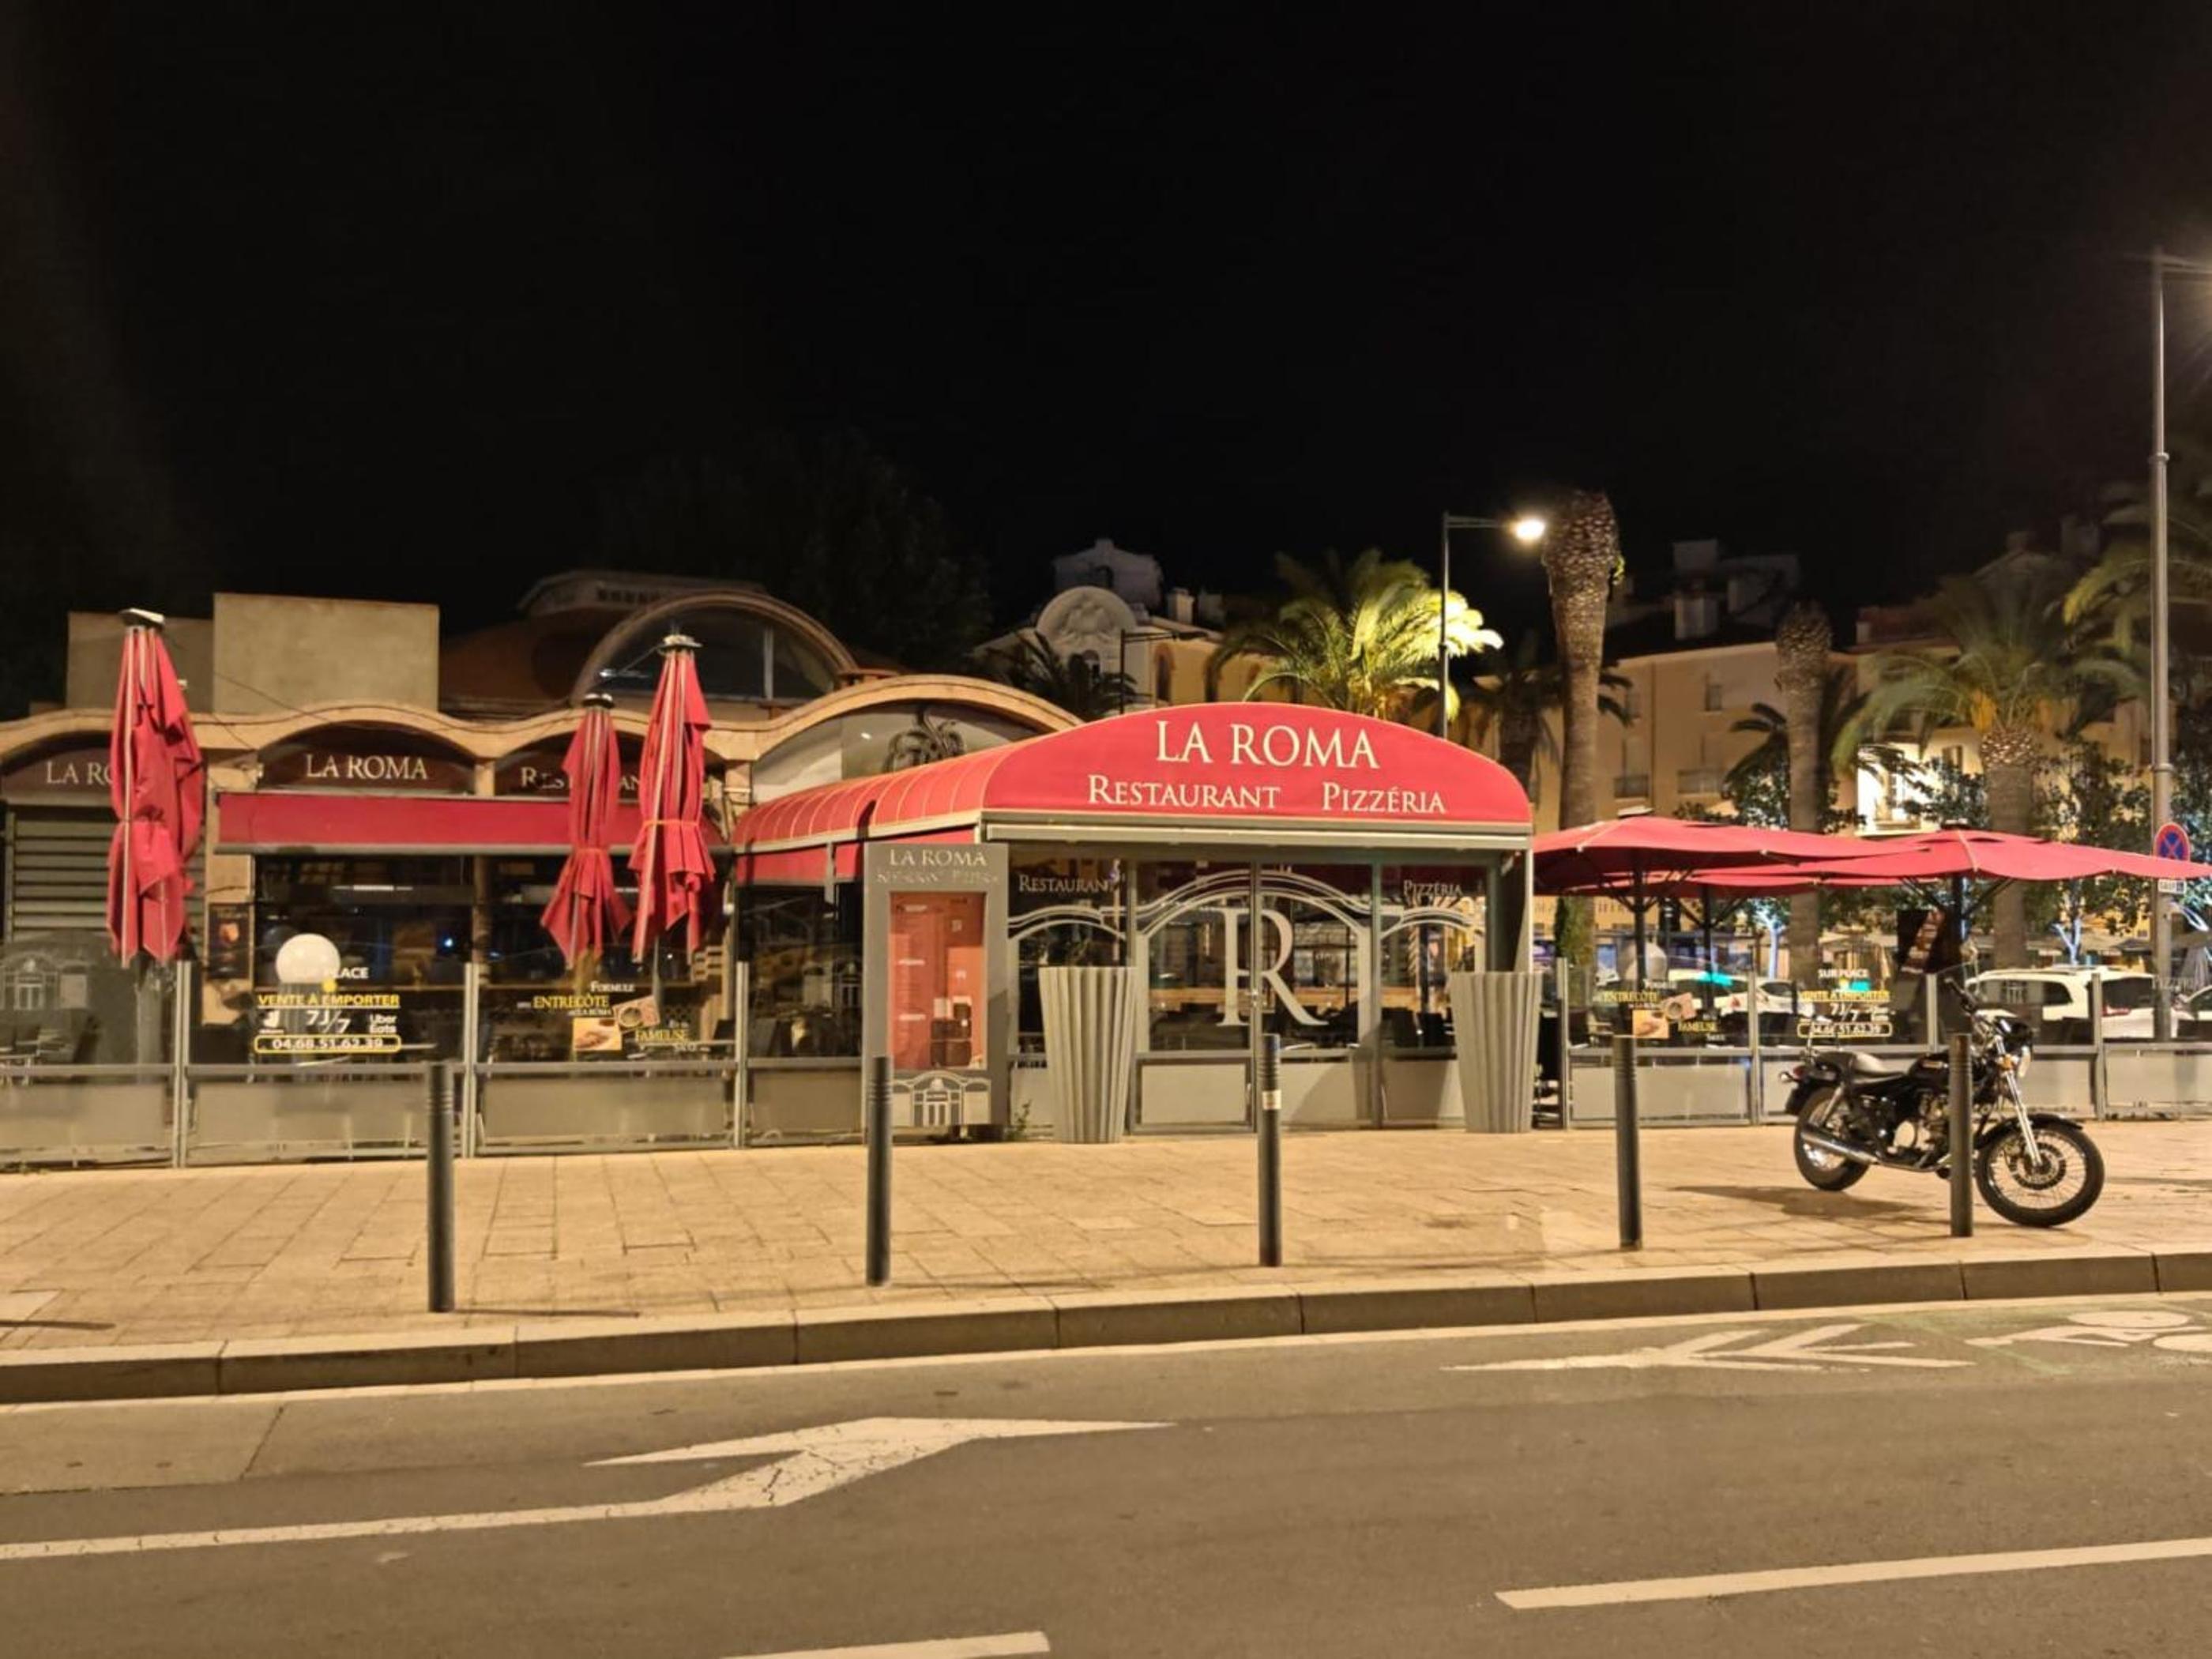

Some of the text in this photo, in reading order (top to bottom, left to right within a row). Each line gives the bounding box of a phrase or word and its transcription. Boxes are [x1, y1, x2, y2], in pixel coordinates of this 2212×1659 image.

[1157, 720, 1381, 769] LA ROMA
[46, 761, 80, 784] LA
[306, 754, 428, 781] LA ROMA
[1088, 774, 1447, 814] RESTAURANT PIZZÉRIA
[889, 848, 988, 867] LA ROMA
[259, 994, 303, 1006] VENTE
[321, 994, 401, 1006] EMPORTER
